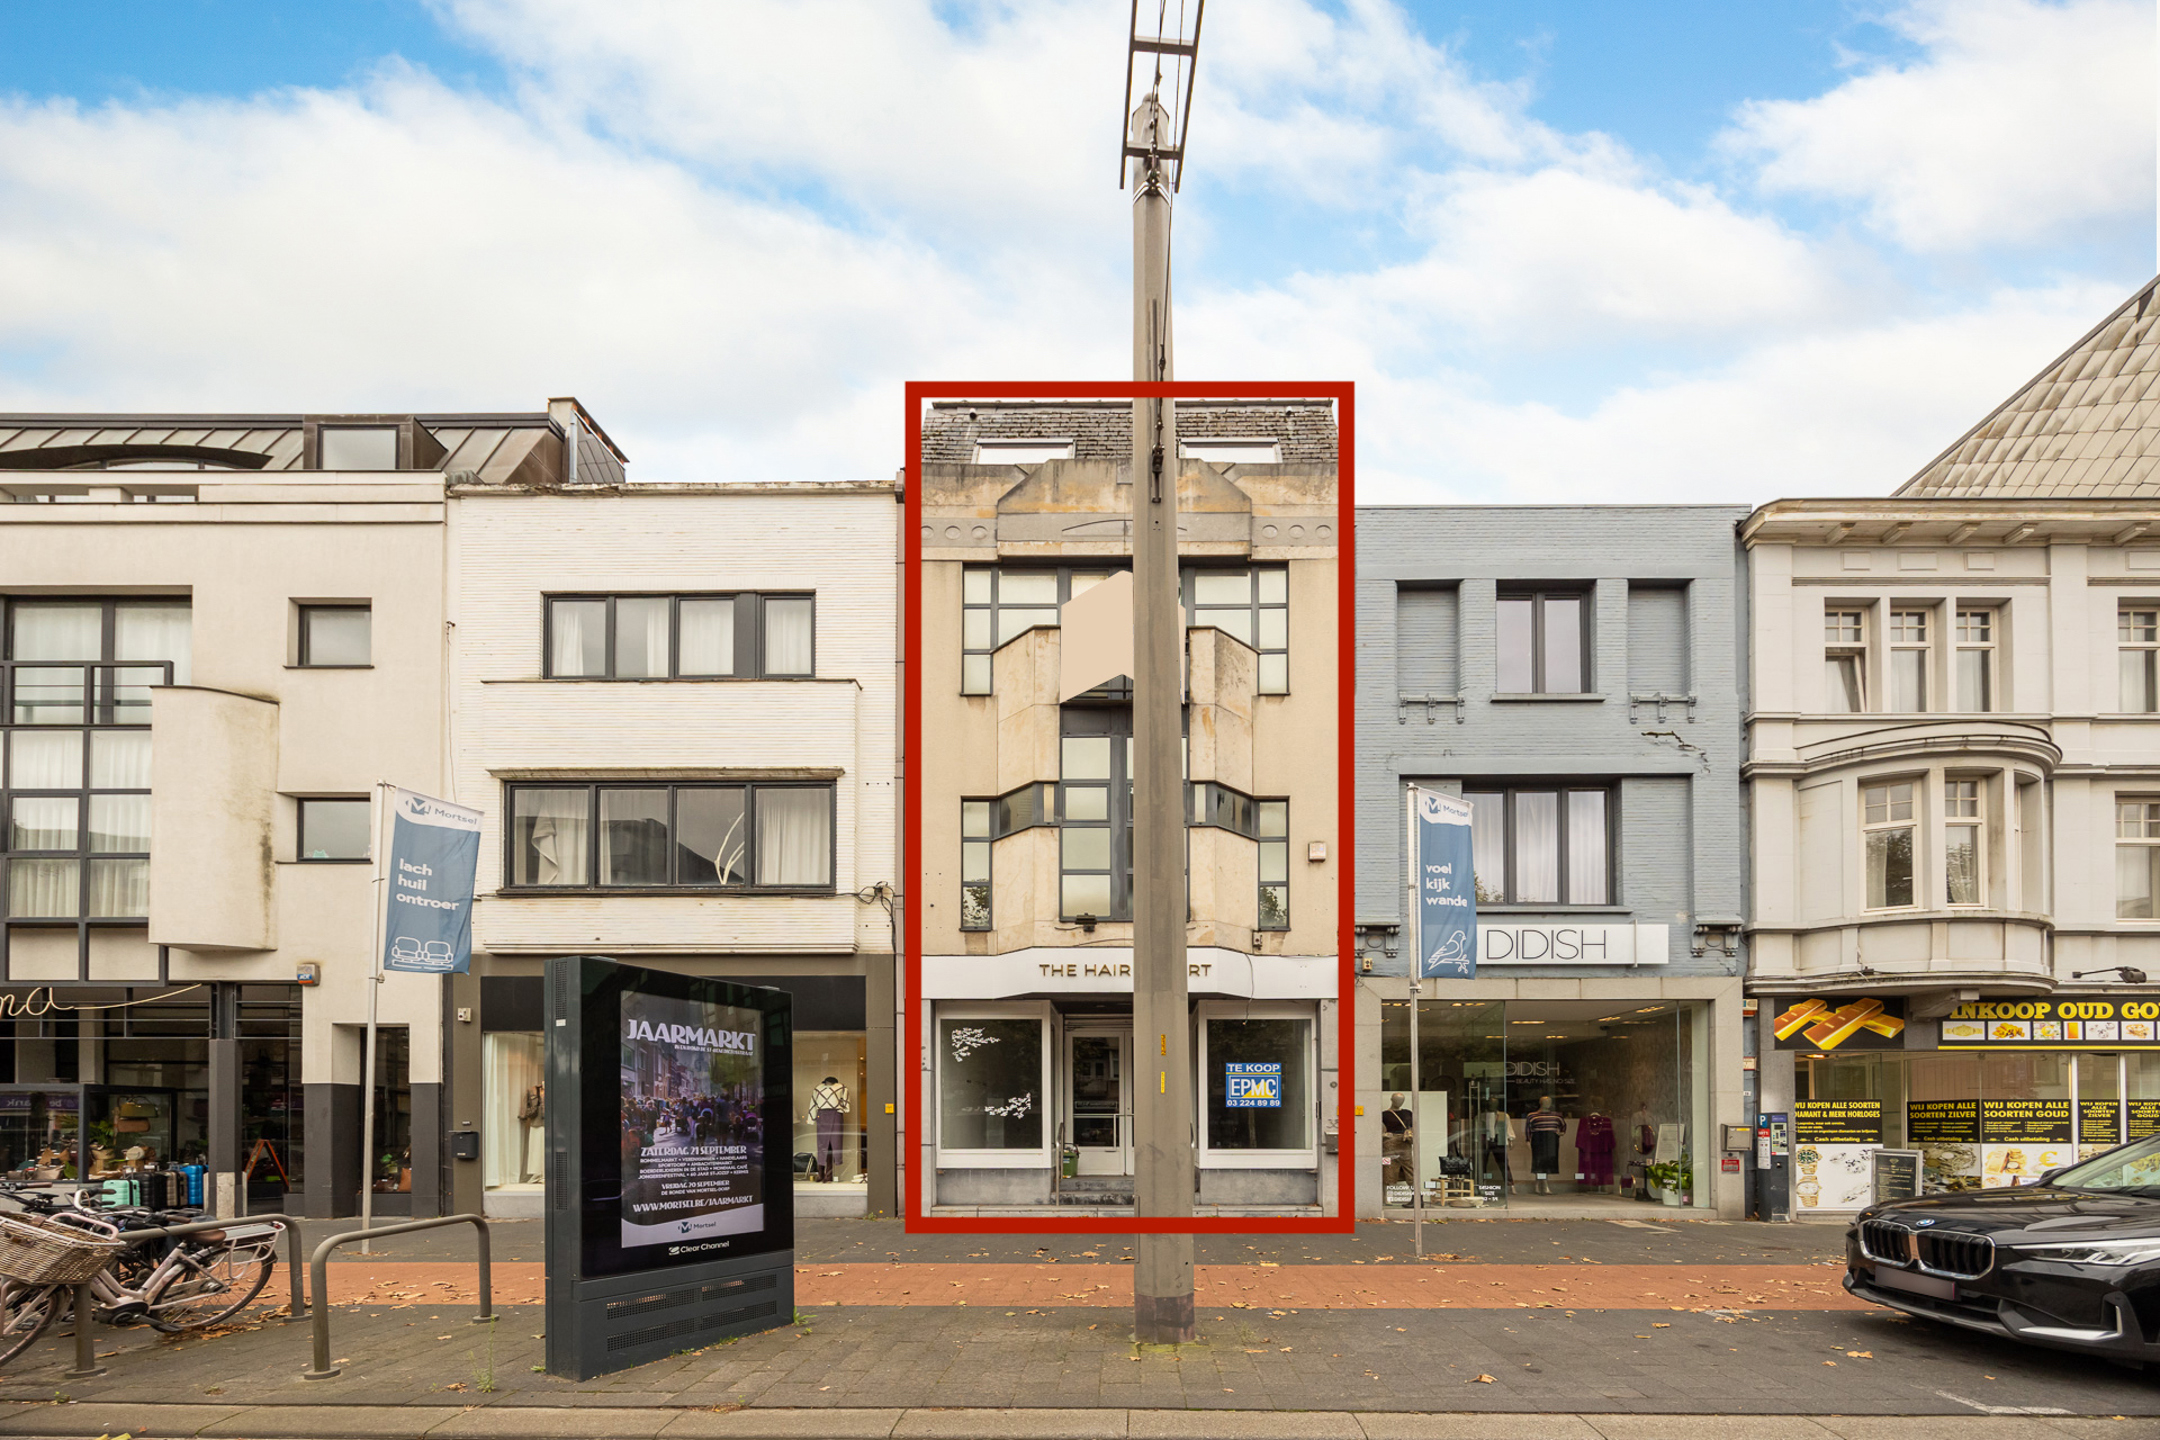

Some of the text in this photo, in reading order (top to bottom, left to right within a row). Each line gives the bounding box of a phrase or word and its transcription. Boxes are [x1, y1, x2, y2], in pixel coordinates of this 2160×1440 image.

[434, 808, 478, 825] Mortsel
[1443, 804, 1468, 818] Mortse
[398, 858, 432, 876] lach
[1425, 862, 1453, 875] voel
[397, 874, 427, 891] huil
[1425, 877, 1451, 893] kijk
[395, 893, 460, 911] ontroer
[1425, 895, 1468, 908] wande
[1486, 929, 1606, 960] DIDISH
[1039, 964, 1132, 977] THE HAIR
[1949, 1002, 2051, 1019] INKOOP
[2057, 1002, 2114, 1019] OUD
[626, 1018, 757, 1051] JAARMARKT
[1227, 1064, 1280, 1072] TE KOOP
[1505, 1061, 1560, 1076] DIDISH
[1231, 1078, 1276, 1096] EPMC
[1807, 1101, 1831, 1109] KOPEN
[1832, 1101, 1847, 1109] ALLE
[1849, 1101, 1880, 1109] SOORTEN
[1957, 1101, 1976, 1109] ALLE
[1983, 1101, 2069, 1109] WIJ KOPEN ALLE
[1760, 1115, 1766, 1126] P
[1822, 1110, 1828, 1118] &
[1829, 1110, 1846, 1118] MERK
[1847, 1110, 1881, 1118] HORLOGES
[1910, 1111, 1946, 1119] SOORTEN
[1984, 1110, 2070, 1118] SOORTEN GOUD
[641, 1145, 747, 1157] ZATERDAG 21 SEPTEMBER
[661, 1182, 688, 1190] VRIJDAG
[697, 1180, 730, 1188] SEPTEMBER
[680, 1241, 730, 1253] Clear Channel
